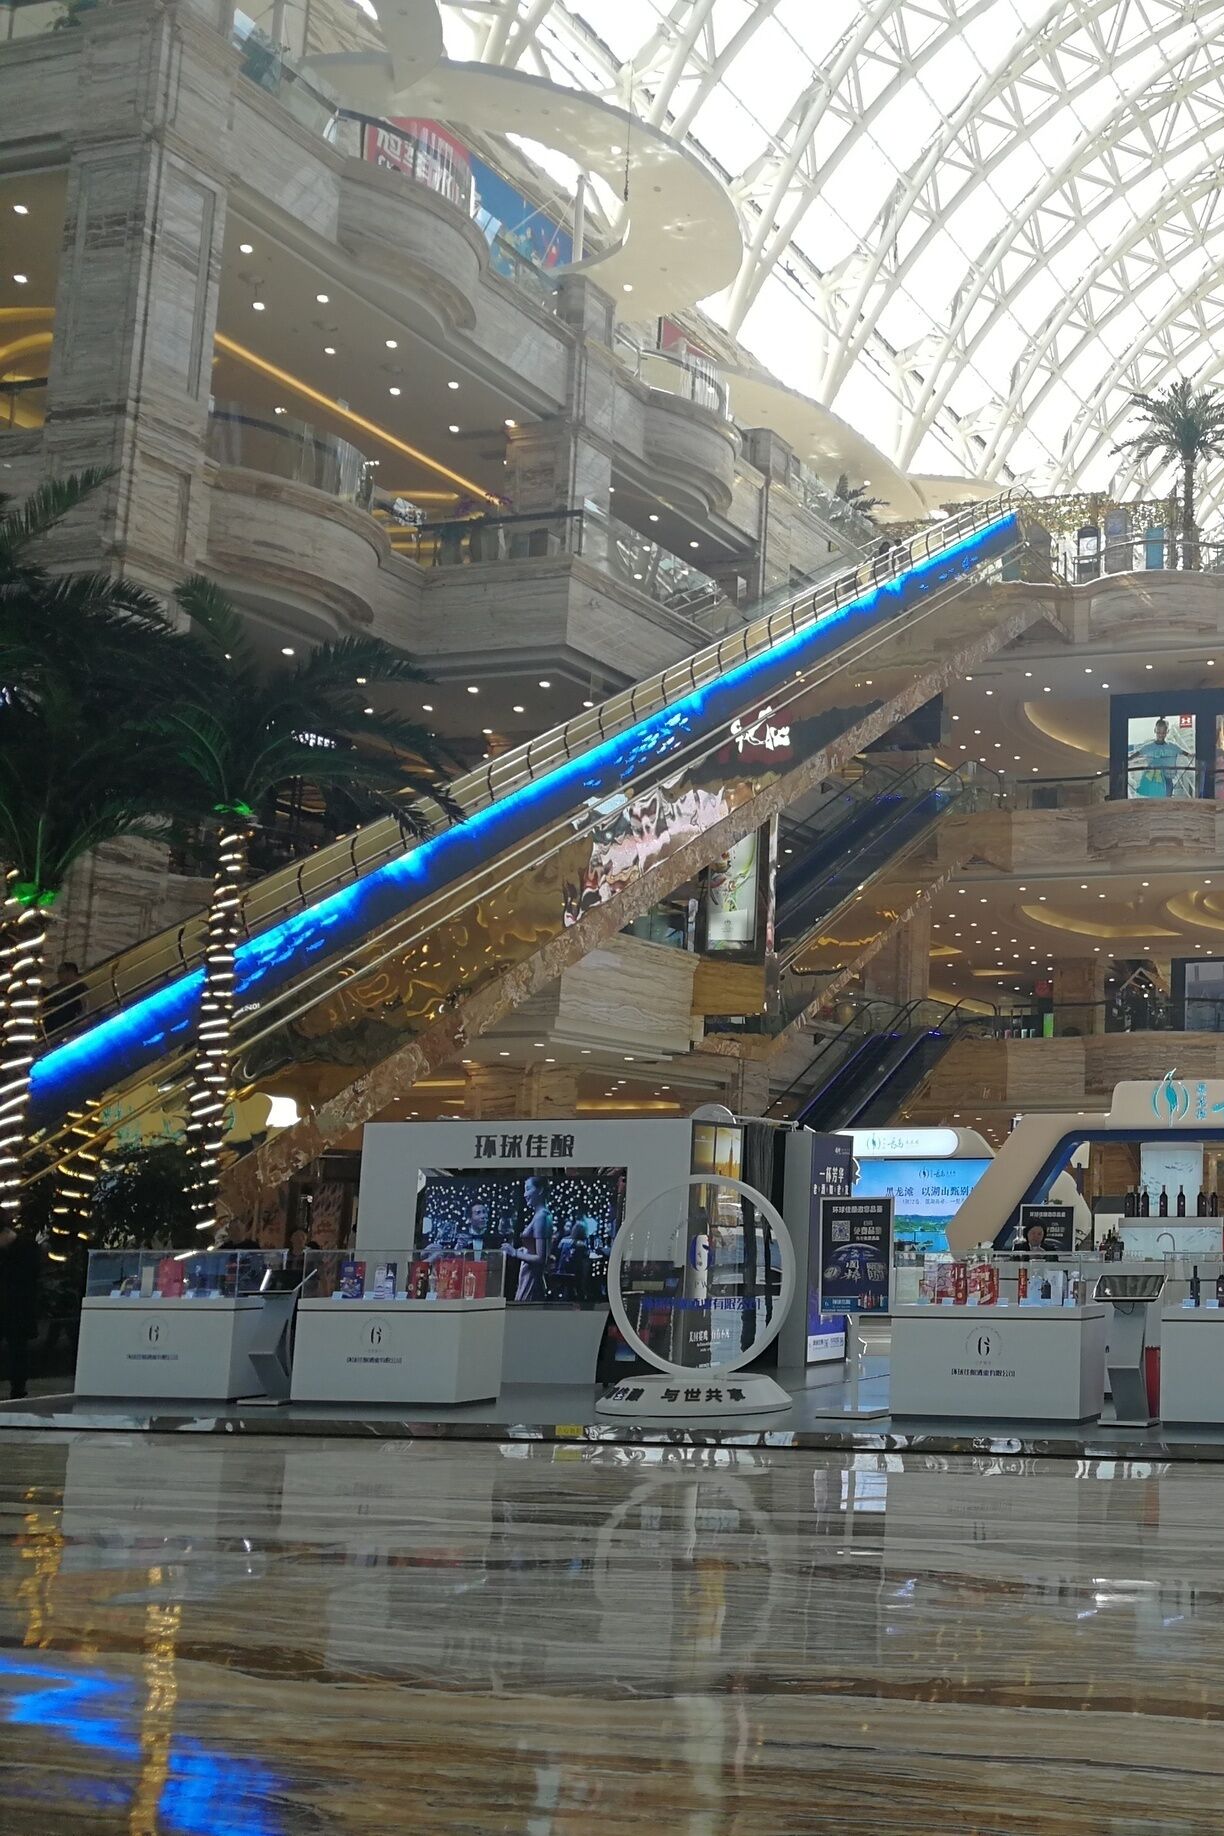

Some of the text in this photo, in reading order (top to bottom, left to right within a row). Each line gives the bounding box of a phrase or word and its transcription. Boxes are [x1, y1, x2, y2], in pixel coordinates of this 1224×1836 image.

[474, 1134, 574, 1159] 环球佳酿
[885, 1186, 914, 1197] 黑龙滩
[660, 1388, 746, 1402] 与世共享
